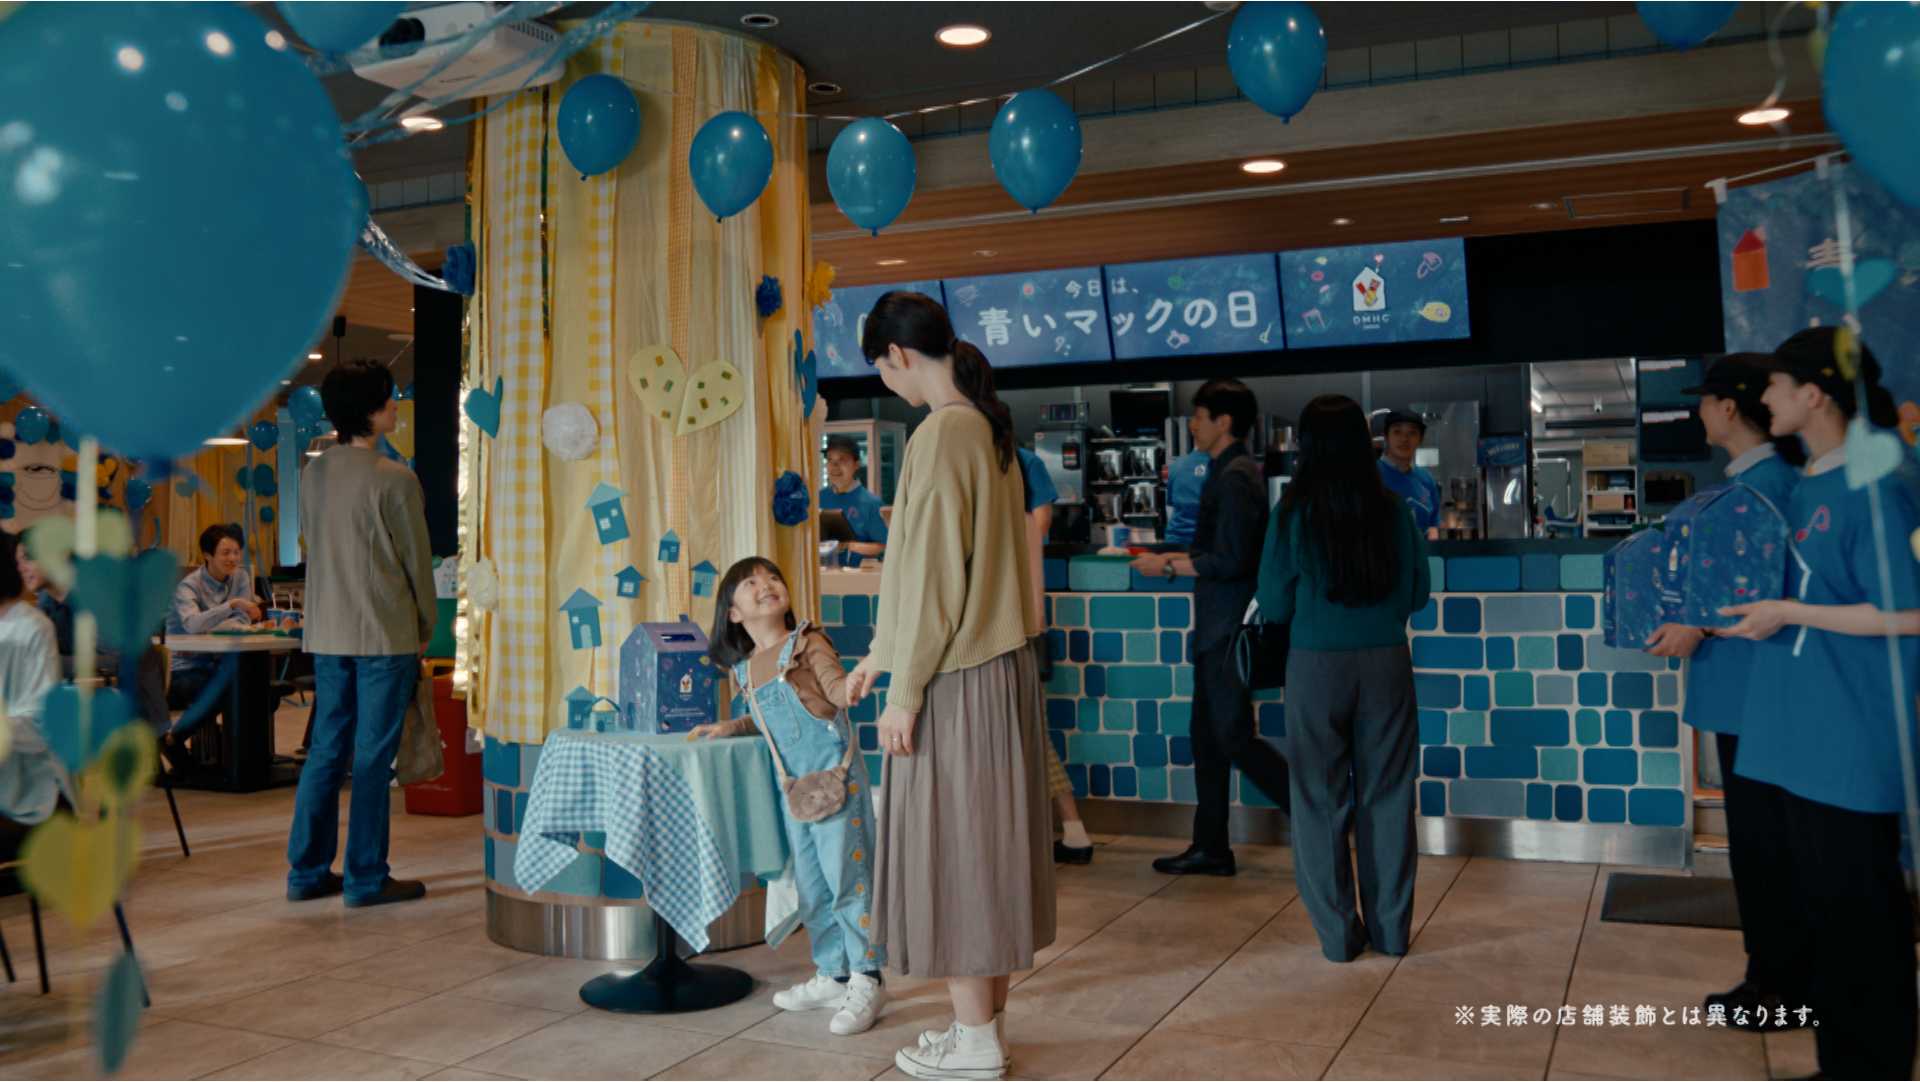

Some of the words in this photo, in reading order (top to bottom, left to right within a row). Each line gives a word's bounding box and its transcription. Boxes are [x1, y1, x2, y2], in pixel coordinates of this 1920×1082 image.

[1065, 278, 1138, 297] 今日は、
[978, 290, 1258, 347] 青いマックの日
